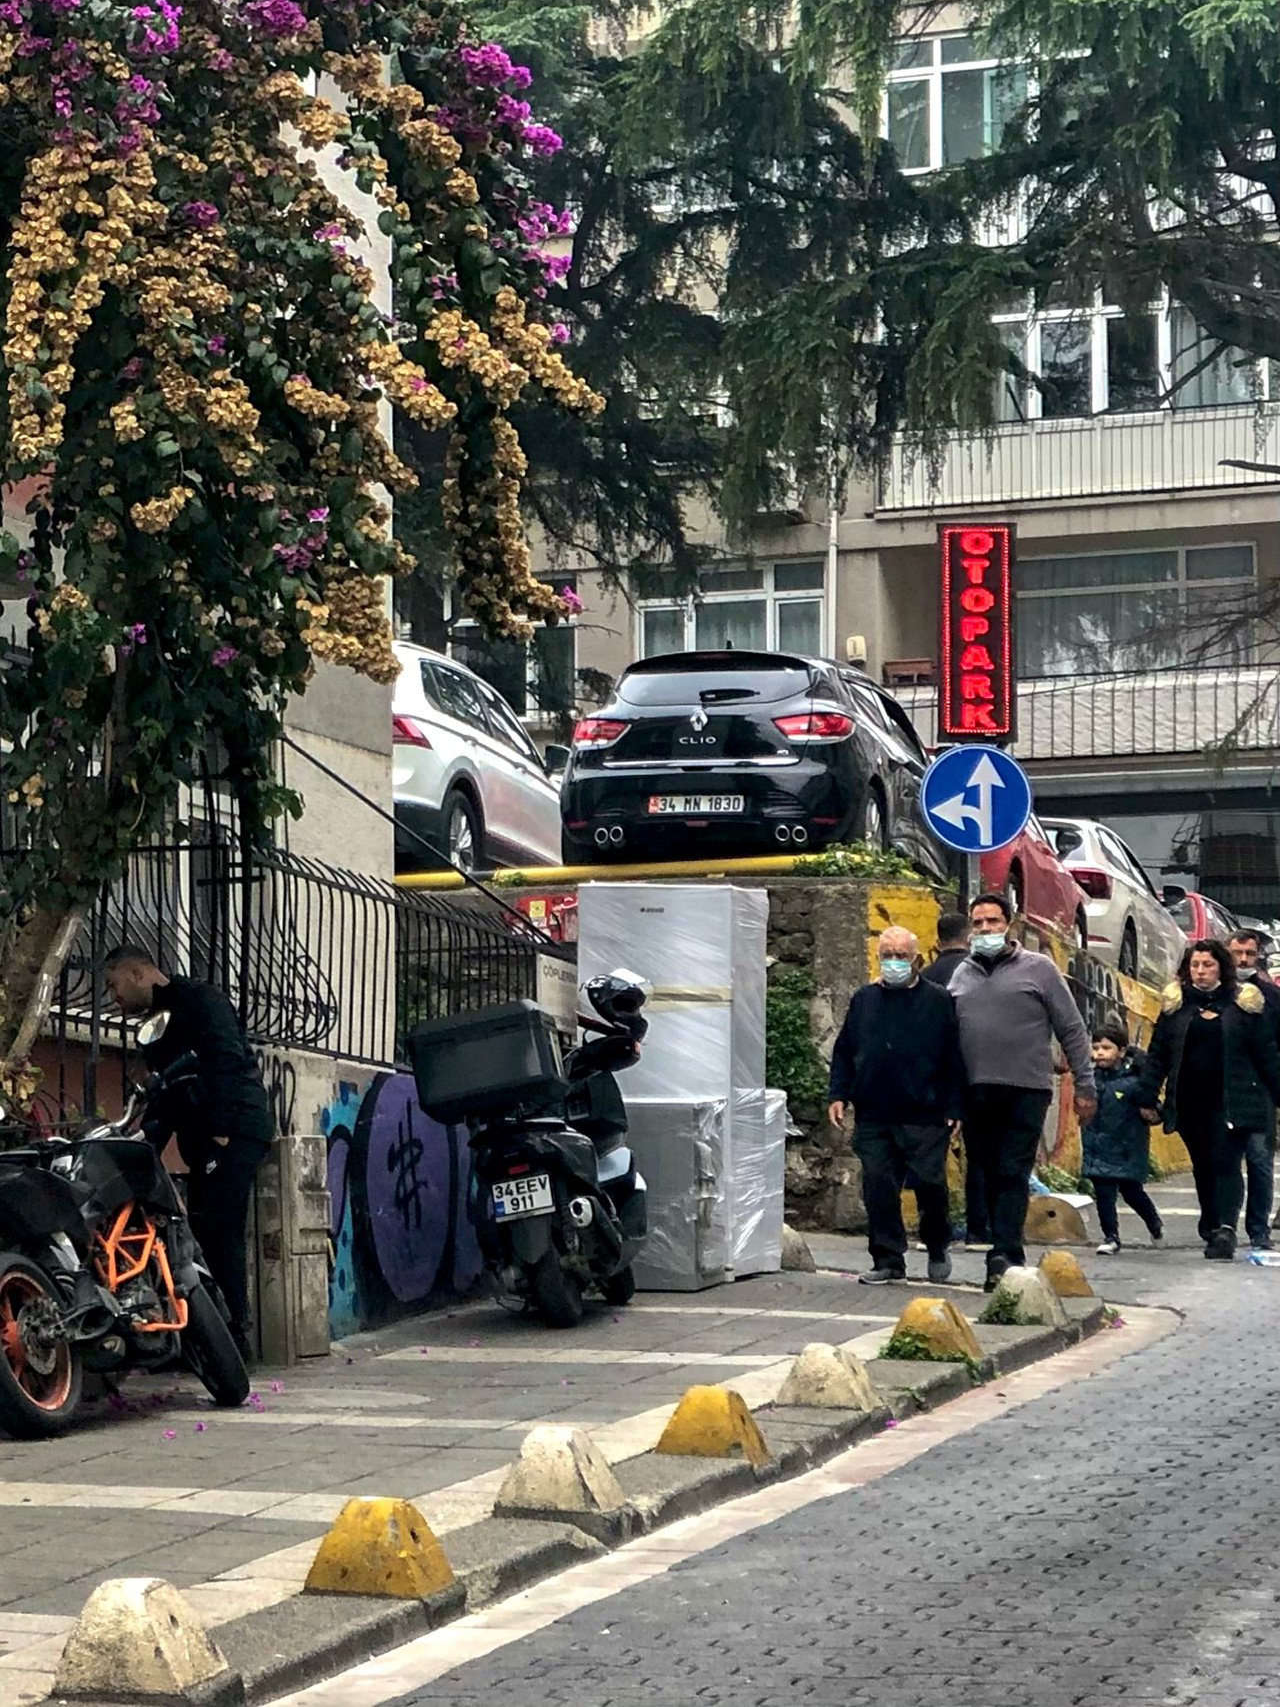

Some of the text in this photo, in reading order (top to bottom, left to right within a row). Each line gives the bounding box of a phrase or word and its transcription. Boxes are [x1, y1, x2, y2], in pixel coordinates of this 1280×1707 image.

[959, 531, 997, 728] OTOPARK
[678, 736, 717, 745] CLIO
[659, 795, 741, 813] 34 MN 1830
[510, 1194, 534, 1211] 911
